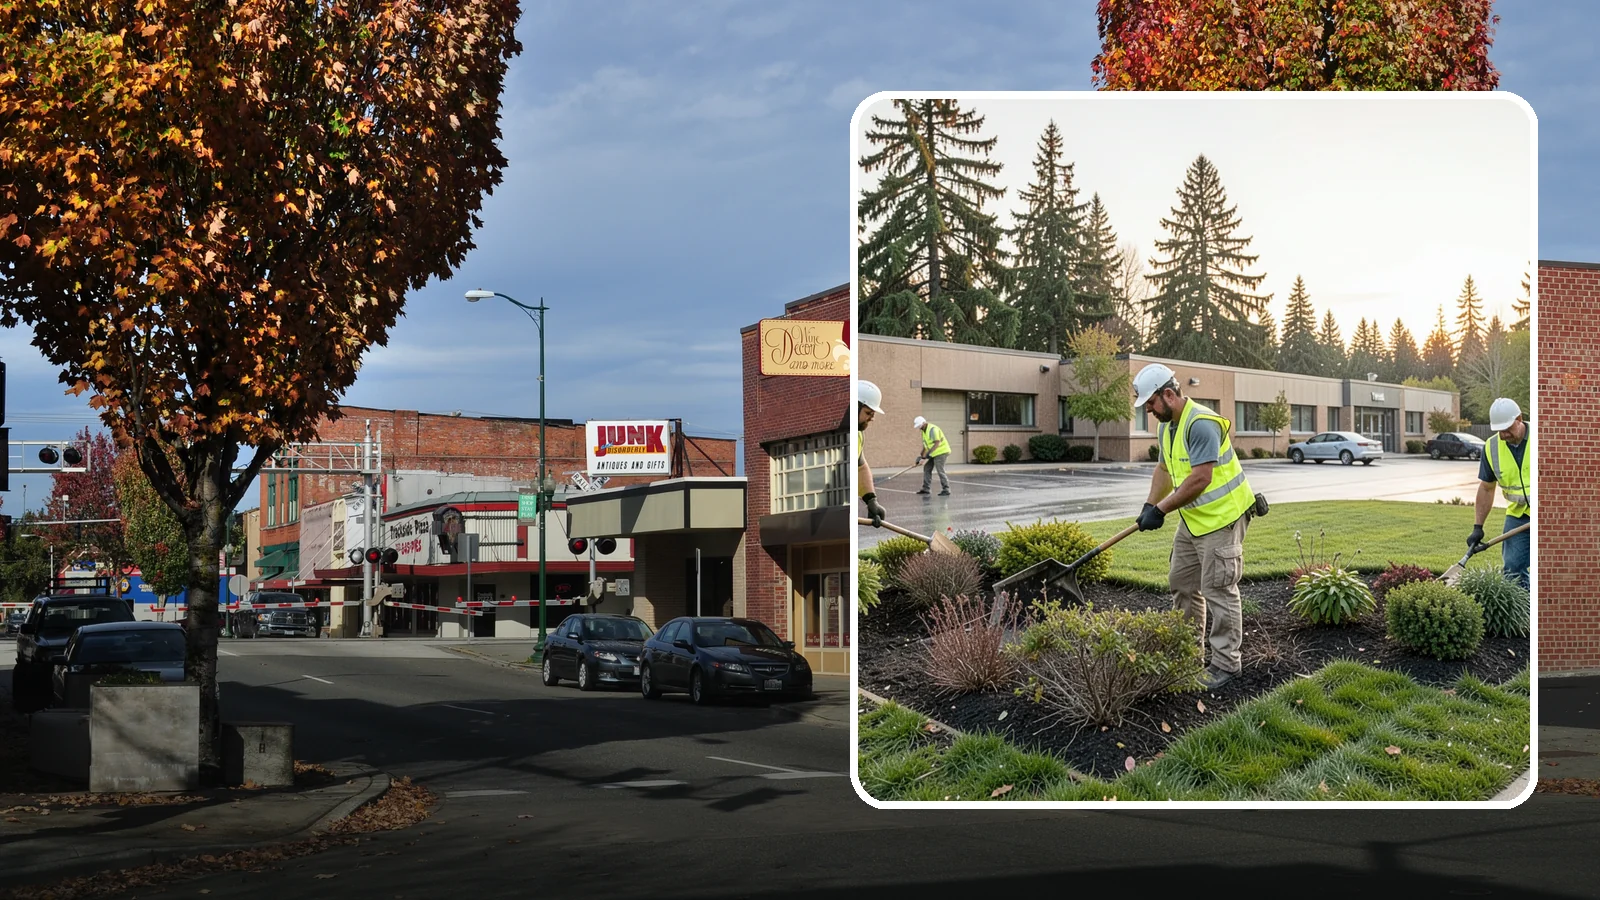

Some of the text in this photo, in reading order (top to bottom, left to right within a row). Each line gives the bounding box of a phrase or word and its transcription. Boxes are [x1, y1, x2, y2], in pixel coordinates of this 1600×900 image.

[596, 426, 665, 457] JUNK
[596, 460, 665, 470] ANTIQUES AND GIFTS
[414, 520, 428, 534] Pizza
